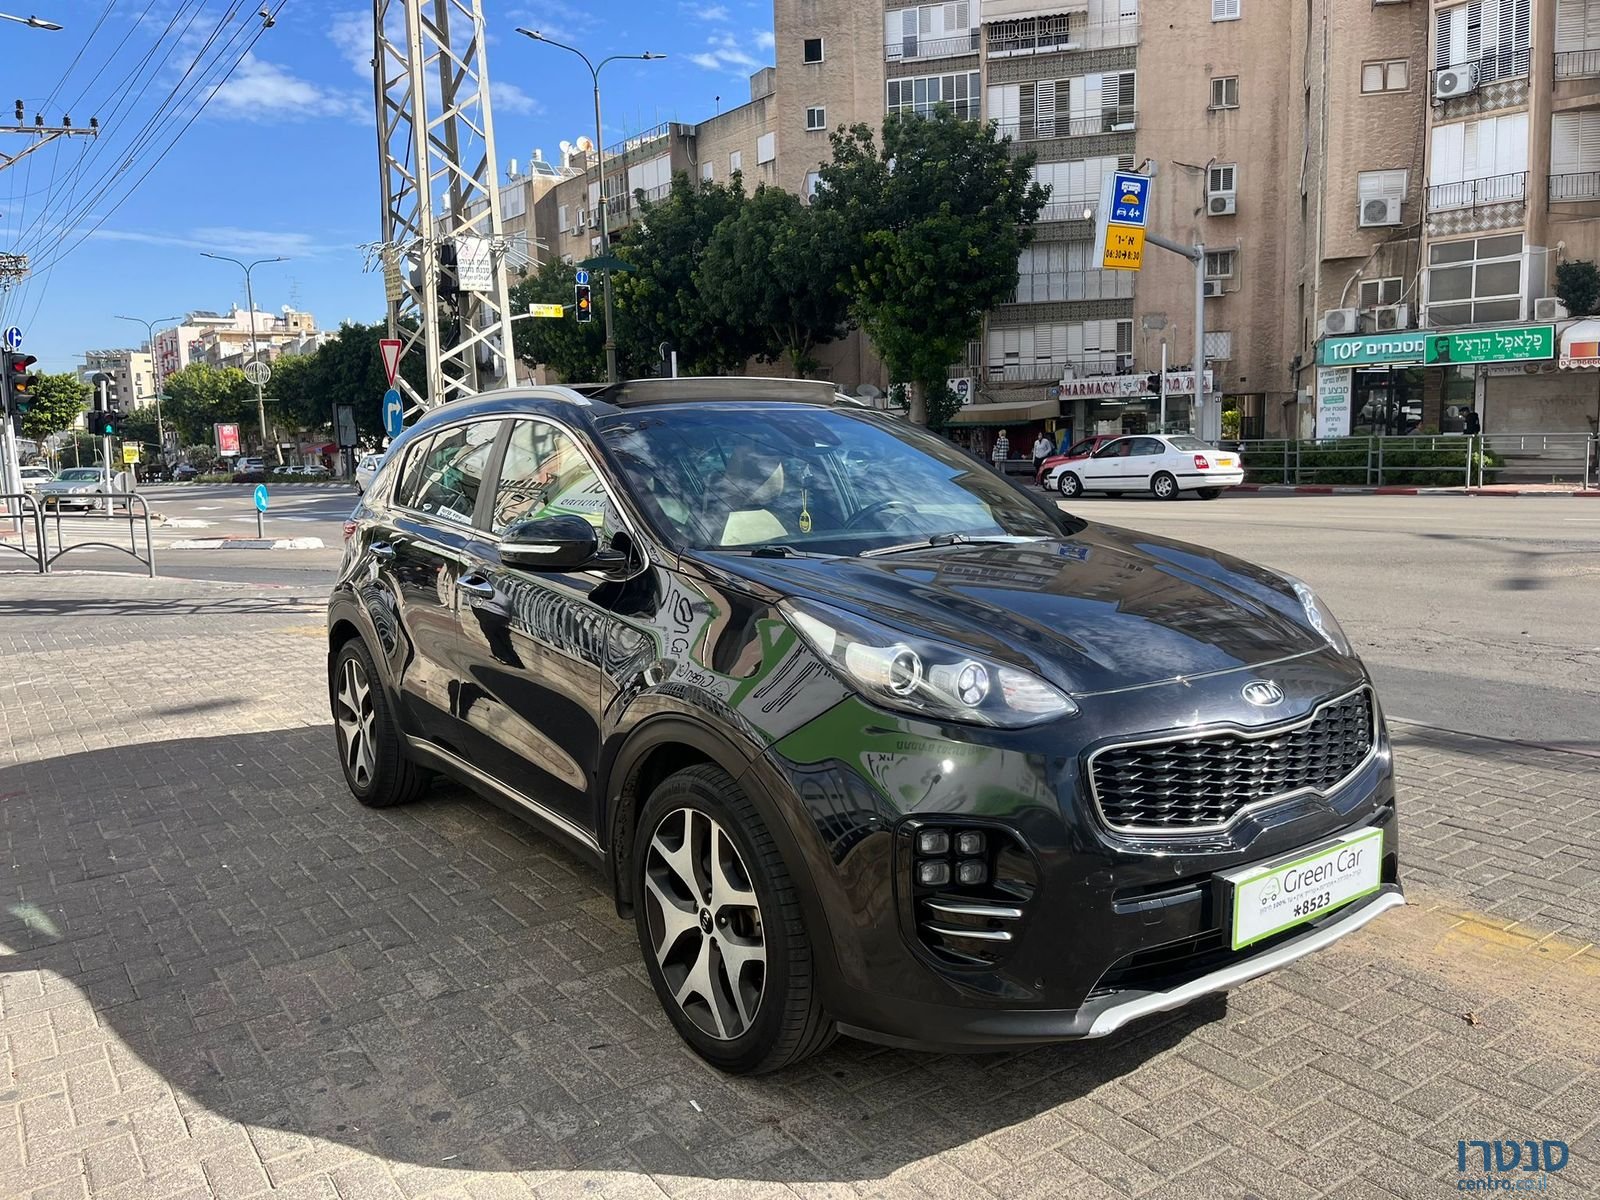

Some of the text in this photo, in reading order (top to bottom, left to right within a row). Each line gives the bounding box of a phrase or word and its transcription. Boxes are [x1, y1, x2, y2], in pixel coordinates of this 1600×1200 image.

[1128, 207, 1140, 218] 4+
[1331, 340, 1424, 360] מטבחים TOP
[1059, 382, 1117, 397] PHARMACY
[1283, 849, 1363, 893] Green Car
